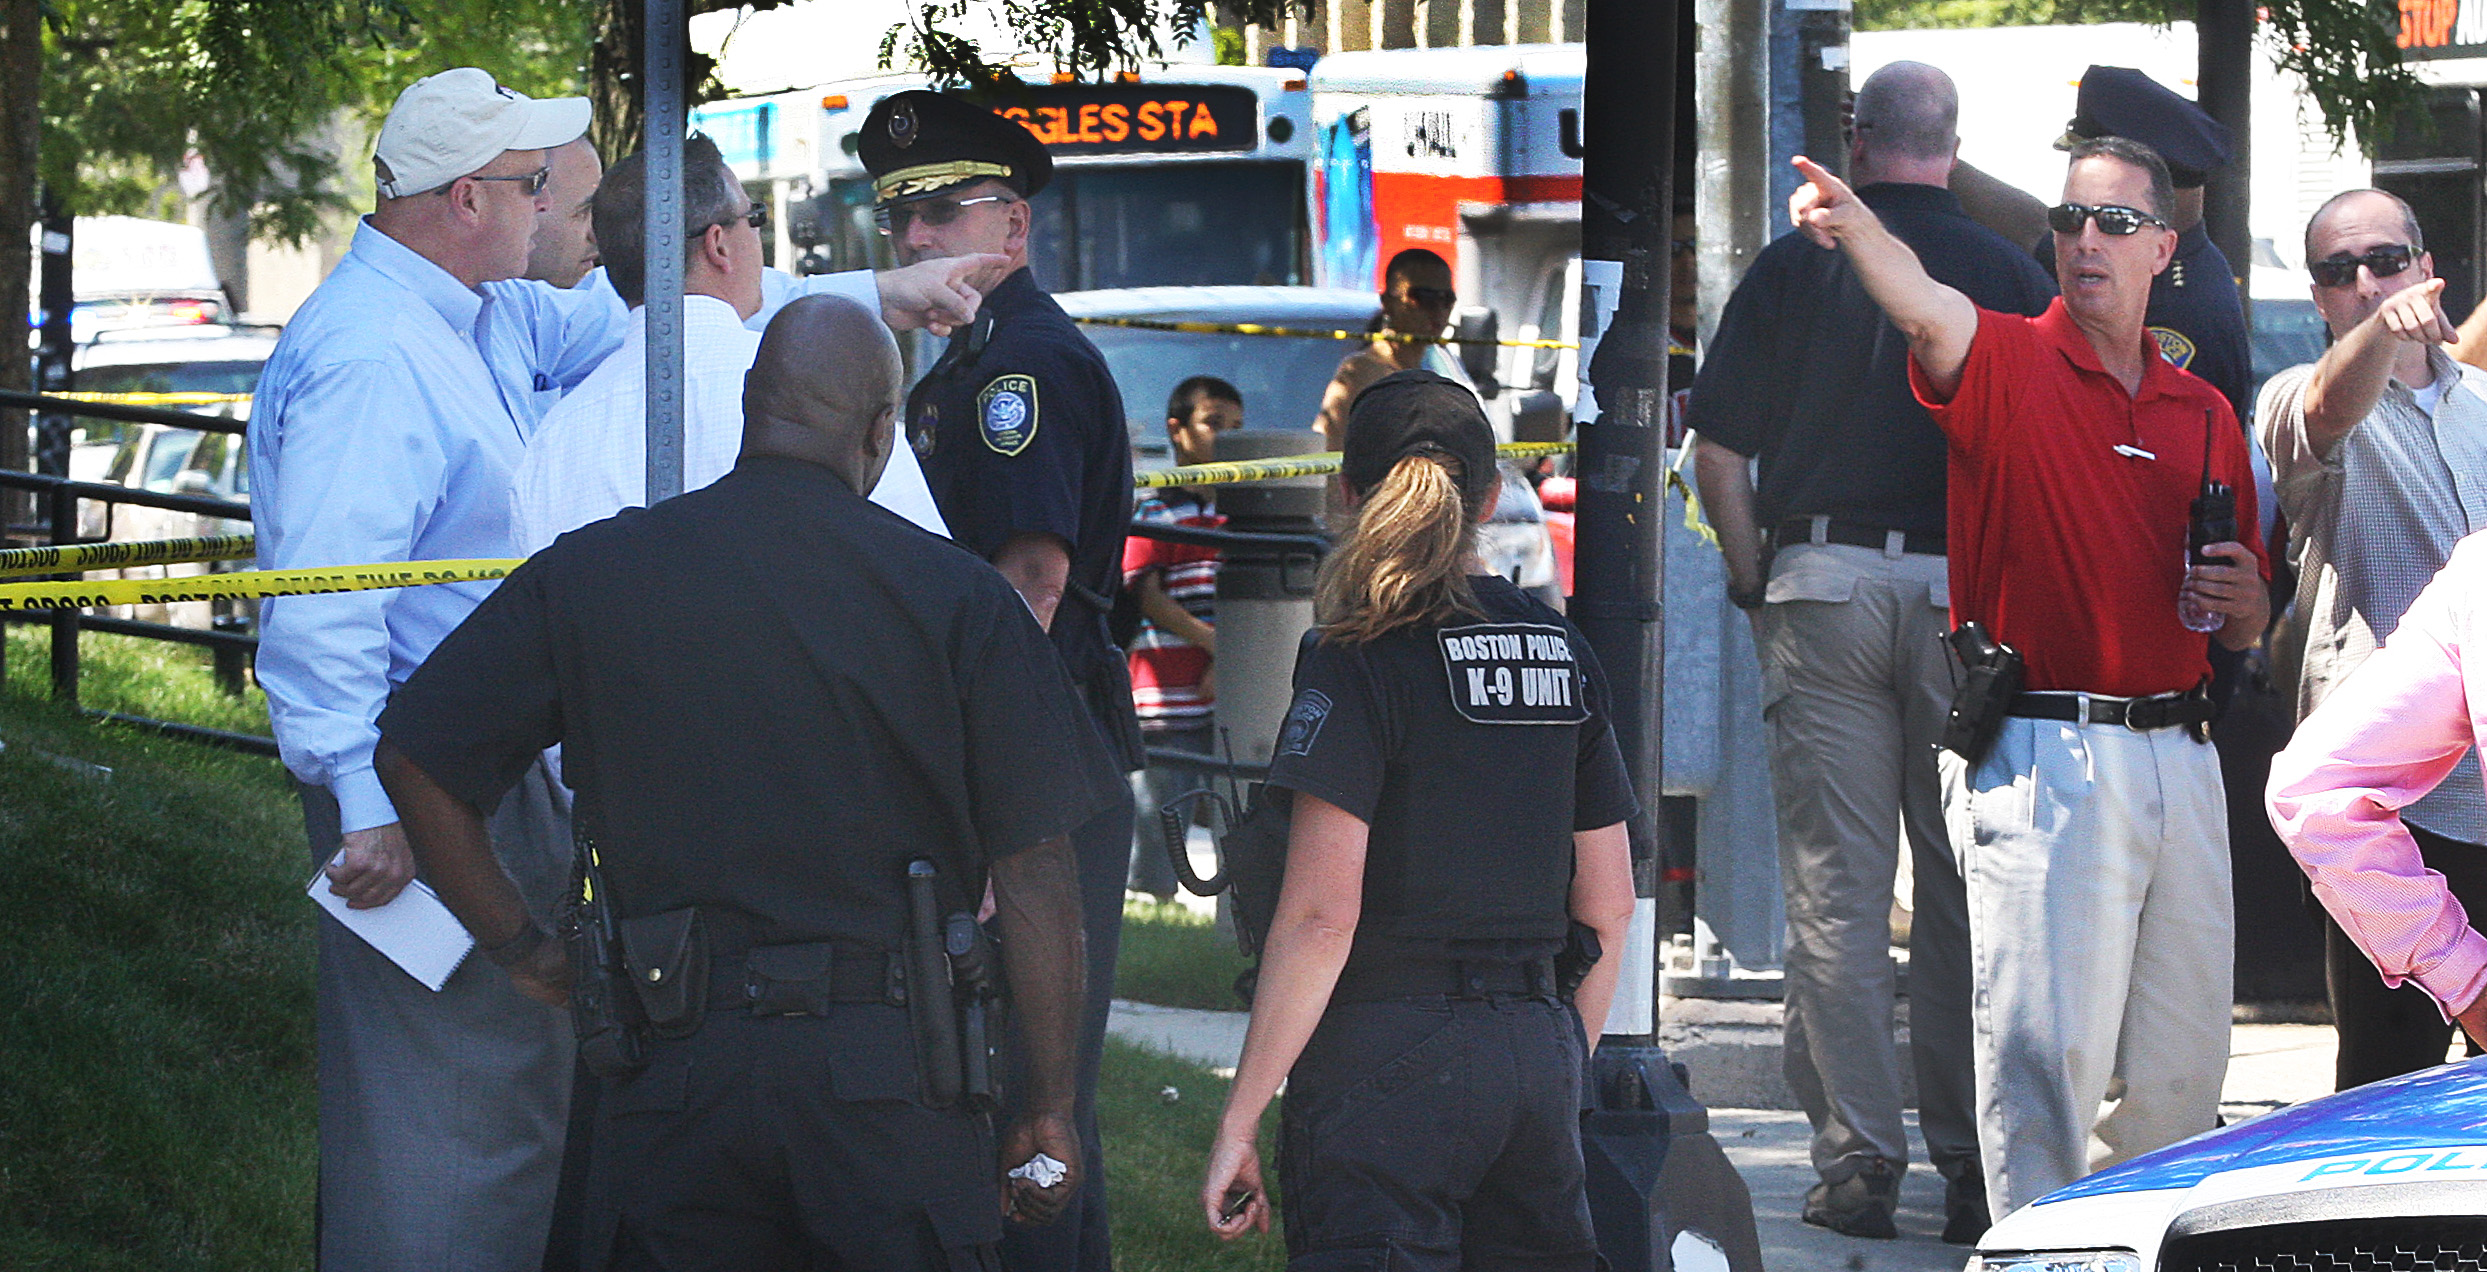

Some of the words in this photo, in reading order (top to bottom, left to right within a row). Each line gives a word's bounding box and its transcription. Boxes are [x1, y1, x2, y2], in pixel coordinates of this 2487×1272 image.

[993, 103, 1131, 144] GGLES
[1138, 101, 1218, 141] STA
[1445, 634, 1523, 661] BOSTON
[1466, 666, 1514, 707] K-9
[1521, 667, 1572, 707] UNIT
